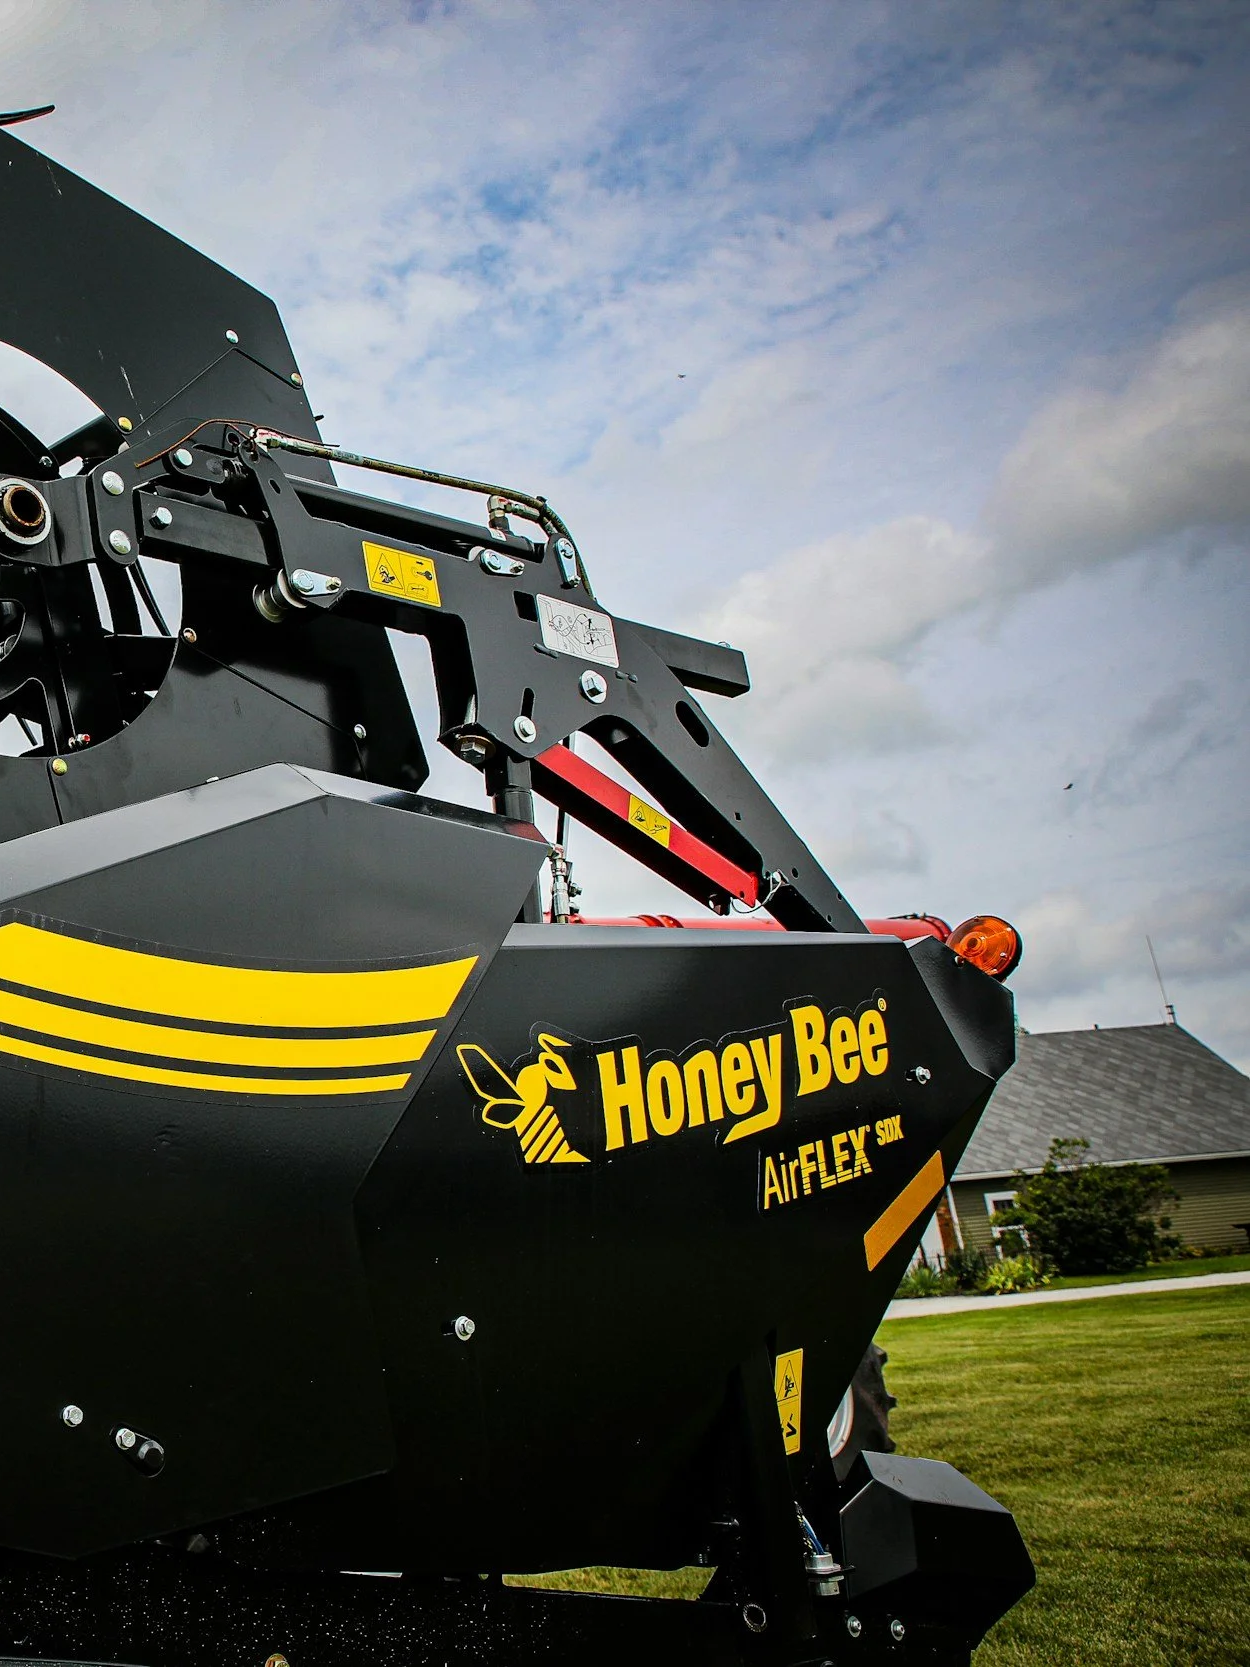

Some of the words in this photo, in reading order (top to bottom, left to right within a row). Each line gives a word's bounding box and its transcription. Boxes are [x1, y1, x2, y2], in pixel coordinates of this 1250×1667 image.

[596, 1033, 783, 1152] Honey
[763, 1126, 873, 1210] AirFLEX
[875, 1114, 904, 1146] SDX
